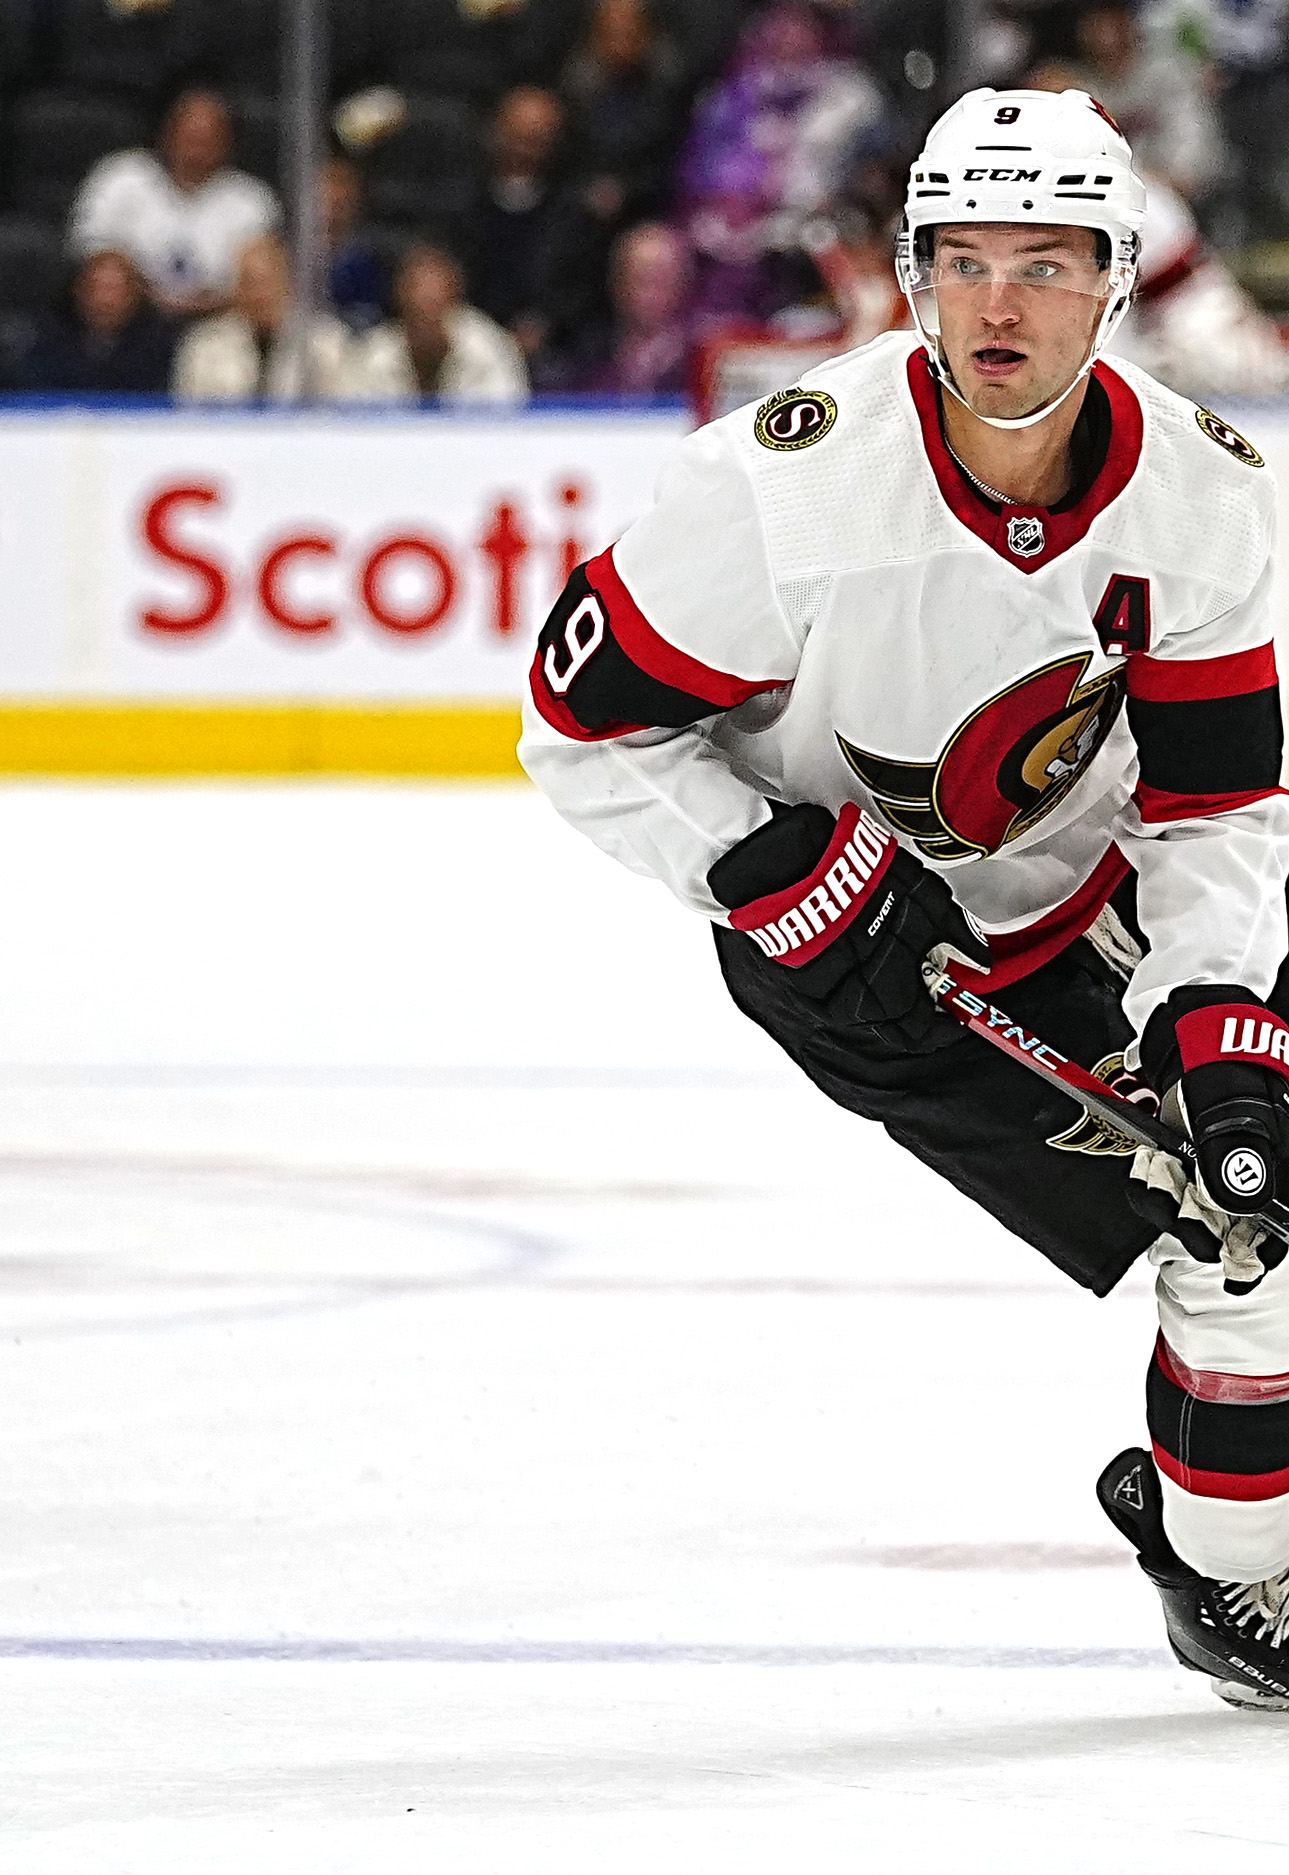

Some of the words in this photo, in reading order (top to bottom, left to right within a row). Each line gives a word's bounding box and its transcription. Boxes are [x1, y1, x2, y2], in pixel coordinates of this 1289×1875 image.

[993, 105, 1022, 125] 9
[962, 168, 1043, 182] CCM
[543, 592, 605, 698] 9
[1091, 572, 1151, 656] A
[745, 808, 893, 958] WARRIOR
[867, 890, 896, 937] COVERT
[951, 990, 1070, 1072] SYNC
